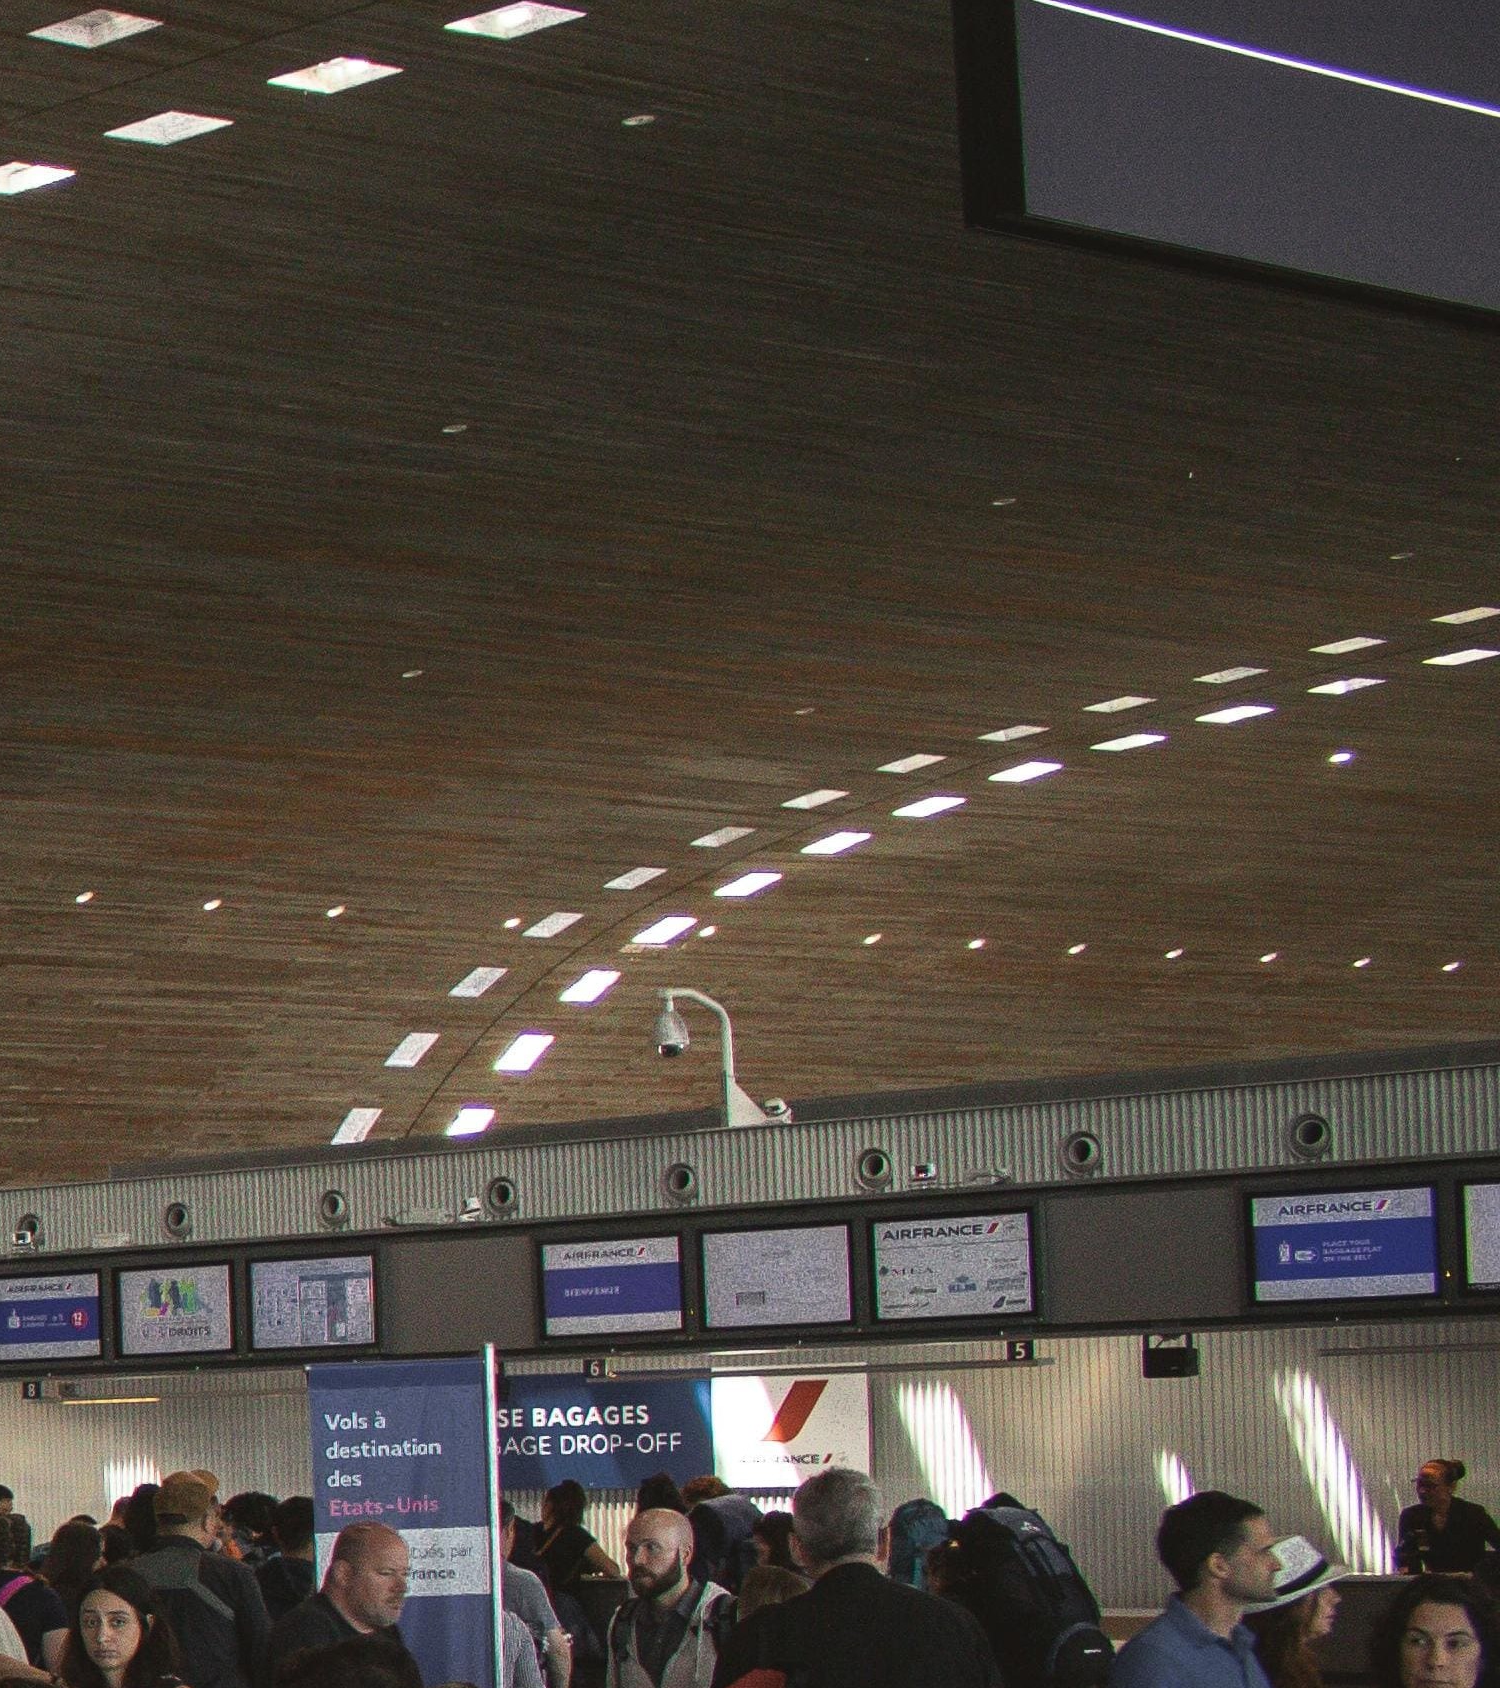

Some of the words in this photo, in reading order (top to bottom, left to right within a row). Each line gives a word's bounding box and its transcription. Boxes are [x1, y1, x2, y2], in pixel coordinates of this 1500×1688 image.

[1278, 1201, 1372, 1215] AIRFRANCE
[882, 1224, 983, 1241] AIRFRANCE
[1013, 1342, 1026, 1360] 5
[589, 1361, 600, 1376] 6
[26, 1383, 36, 1399] 8
[324, 1412, 368, 1431] Vols
[373, 1411, 387, 1431] à
[532, 1405, 650, 1427] BAGAGES
[325, 1437, 442, 1460] destination
[560, 1432, 683, 1455] DROP-OFF
[327, 1468, 362, 1488] des
[329, 1496, 439, 1518] Etats-Unis
